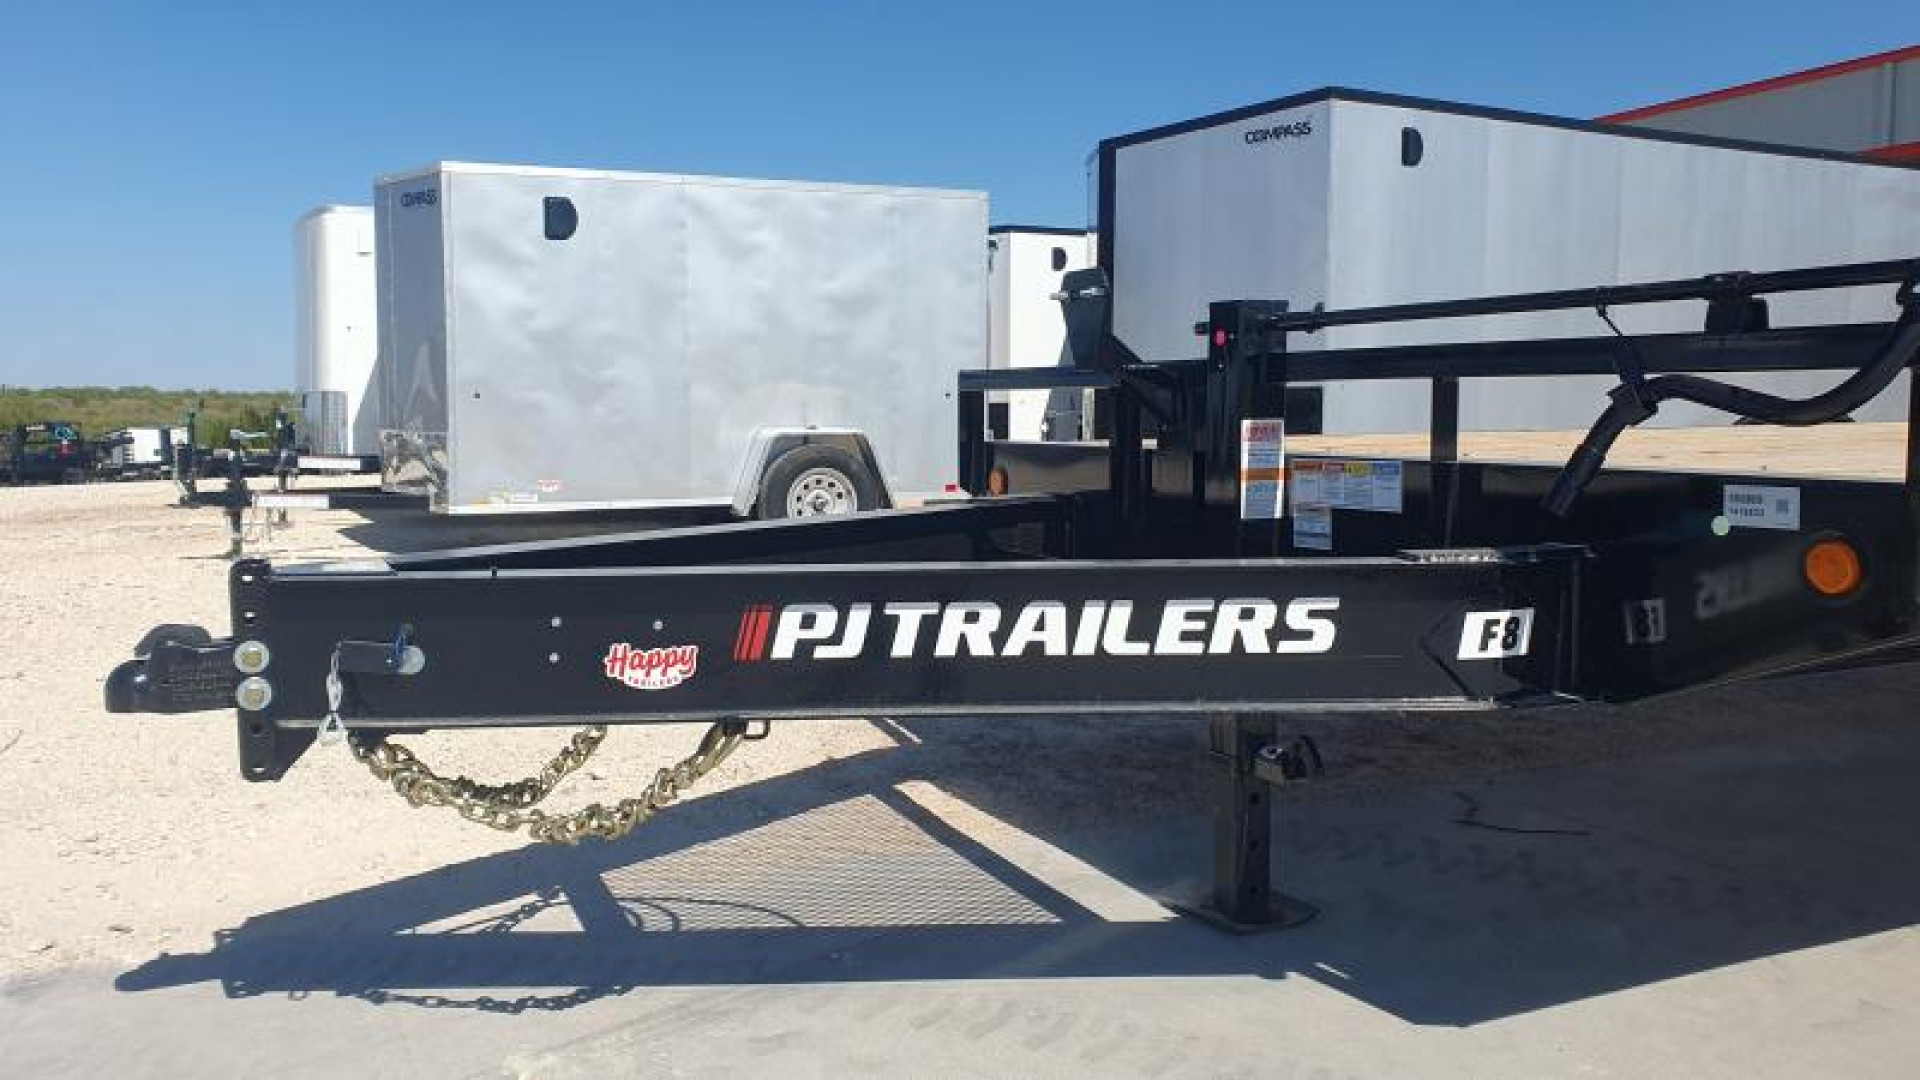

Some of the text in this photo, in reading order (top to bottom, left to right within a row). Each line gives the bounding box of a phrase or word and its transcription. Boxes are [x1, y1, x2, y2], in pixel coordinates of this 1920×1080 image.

[770, 597, 1340, 660] PJ TRAILERS
[1479, 617, 1520, 651] F8
[606, 644, 698, 678] Happy
